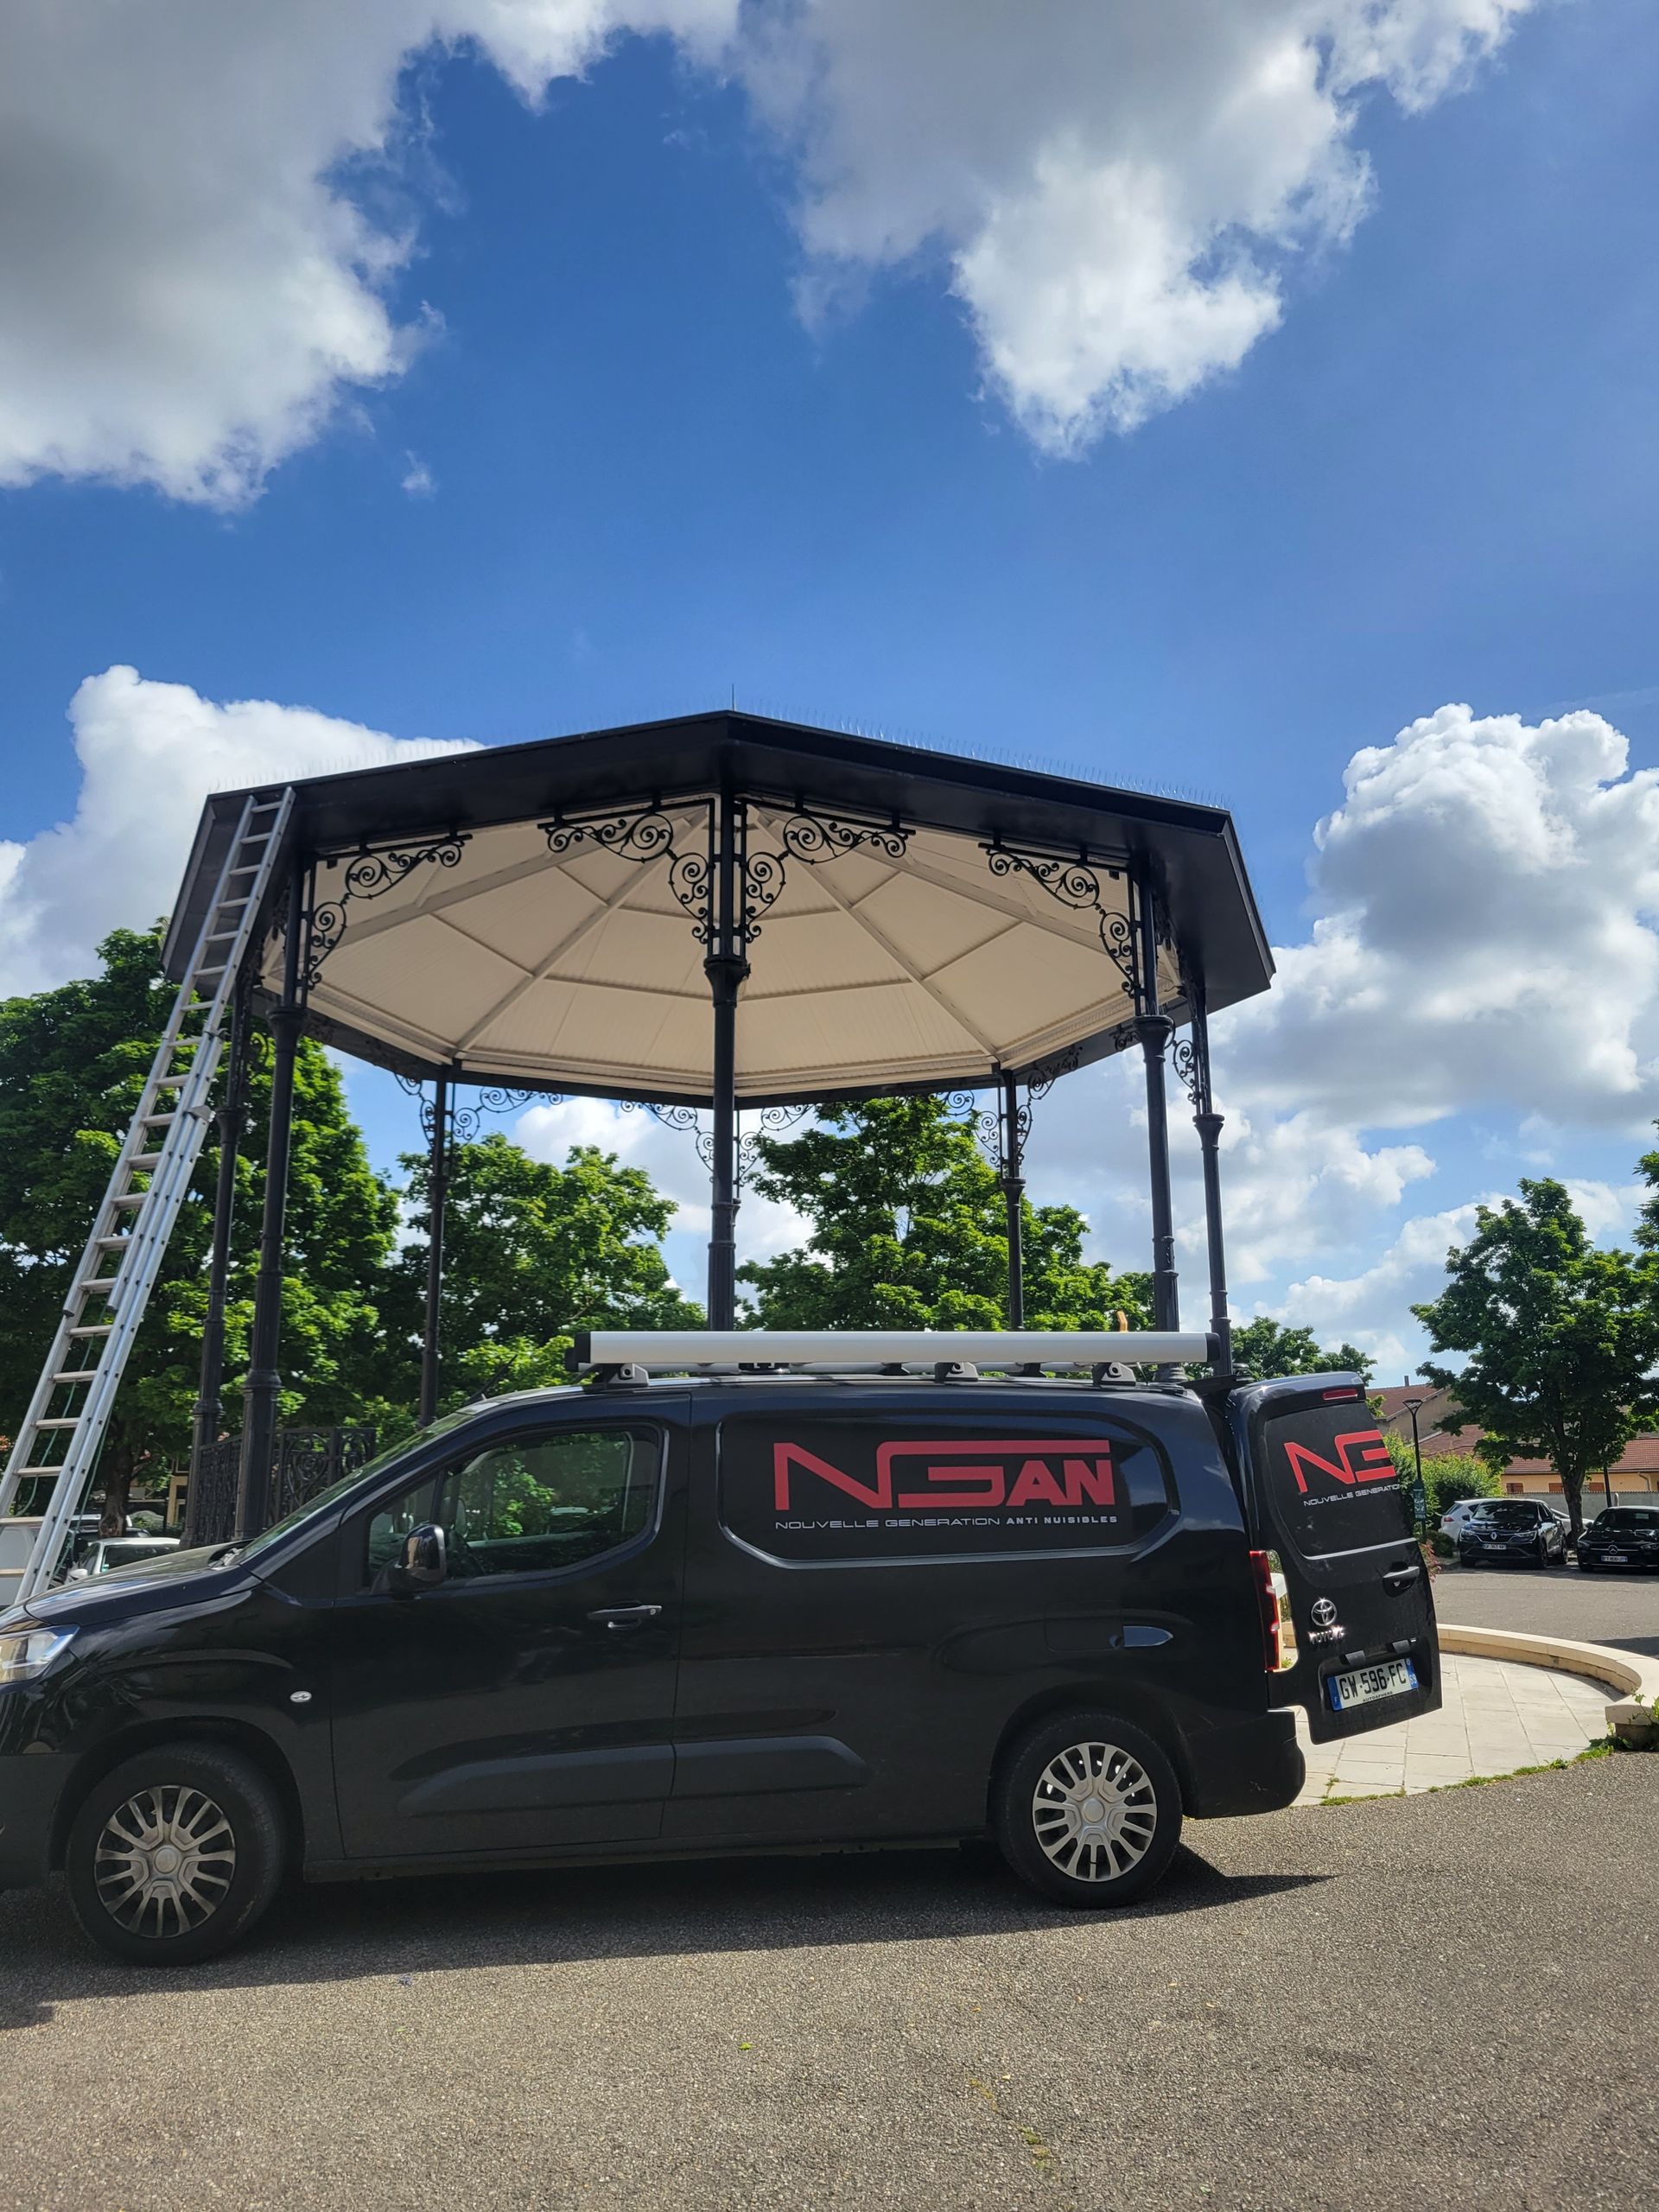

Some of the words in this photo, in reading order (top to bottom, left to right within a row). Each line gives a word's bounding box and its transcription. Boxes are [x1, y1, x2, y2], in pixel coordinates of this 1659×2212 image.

[1303, 1491, 1354, 1507] NOUVELLE
[1355, 1484, 1400, 1497] GENERATIO
[775, 1520, 879, 1529] NOUVELLE
[885, 1517, 1000, 1528] GENERATION
[1006, 1516, 1038, 1525] ANTI
[1044, 1516, 1118, 1524] NUISIBLES
